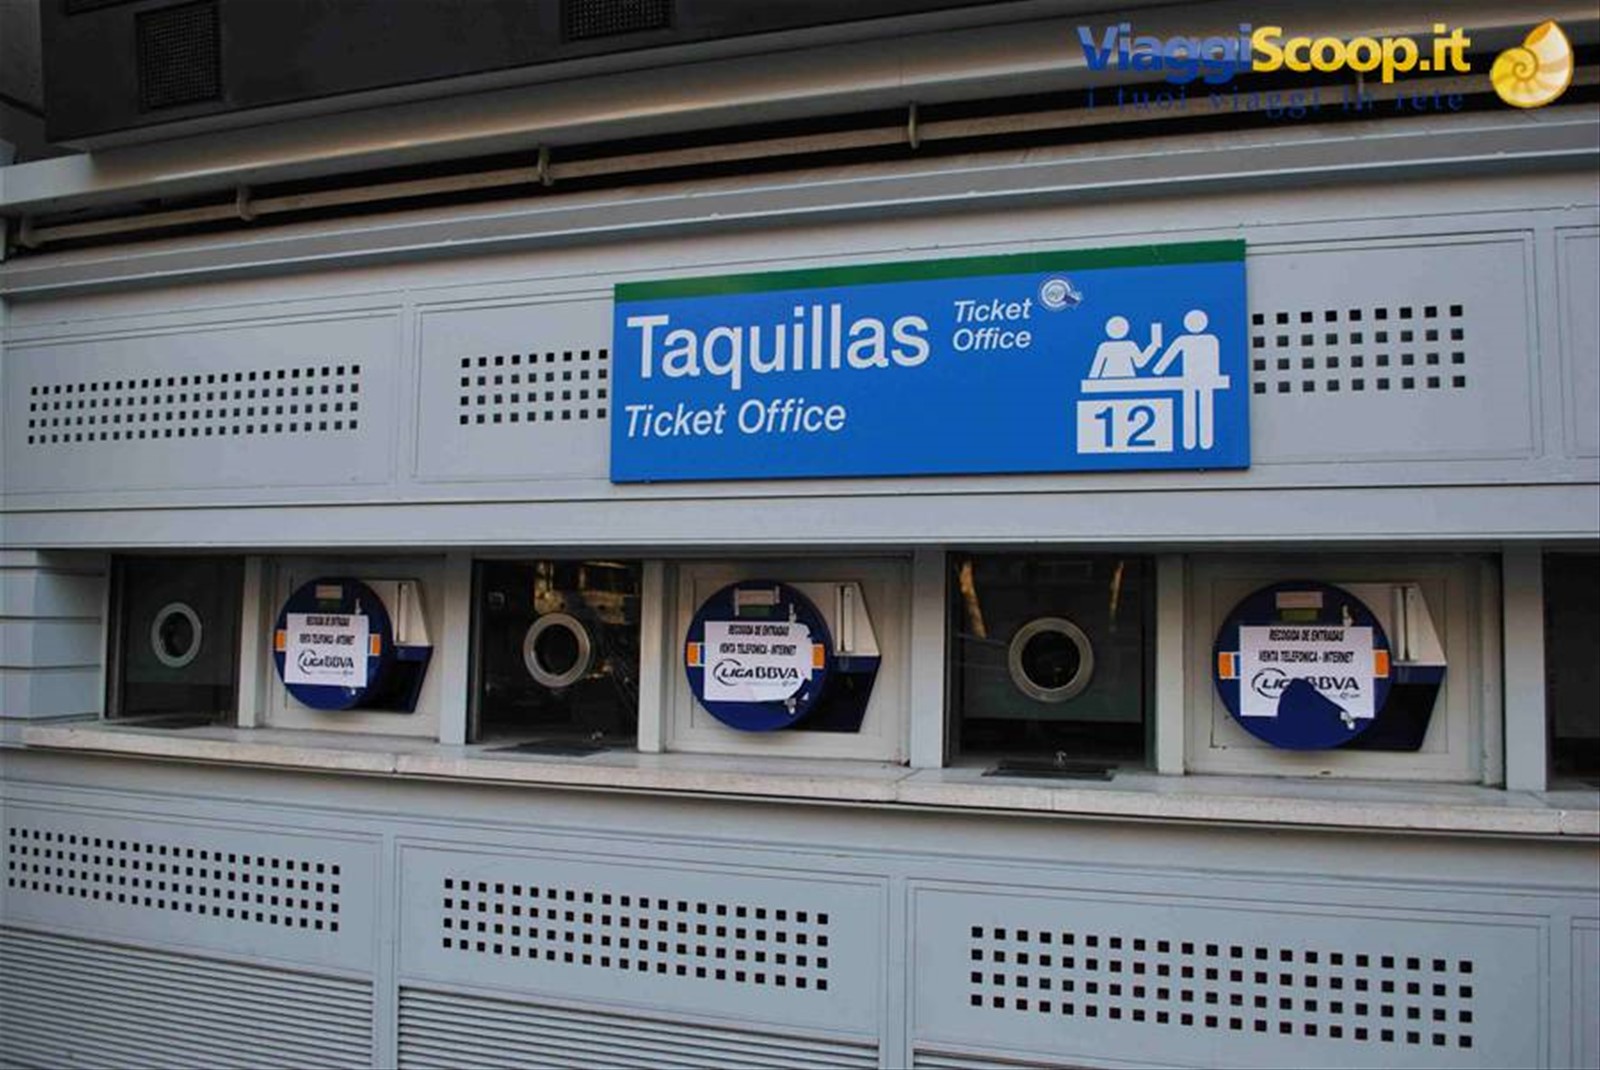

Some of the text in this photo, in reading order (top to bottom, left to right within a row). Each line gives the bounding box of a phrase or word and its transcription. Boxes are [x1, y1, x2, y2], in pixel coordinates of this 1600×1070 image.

[953, 297, 1032, 324] Ticket
[626, 303, 930, 390] Taquillas
[952, 325, 1032, 352] Office
[624, 397, 847, 439] Ticket Office
[1093, 404, 1158, 449] 12
